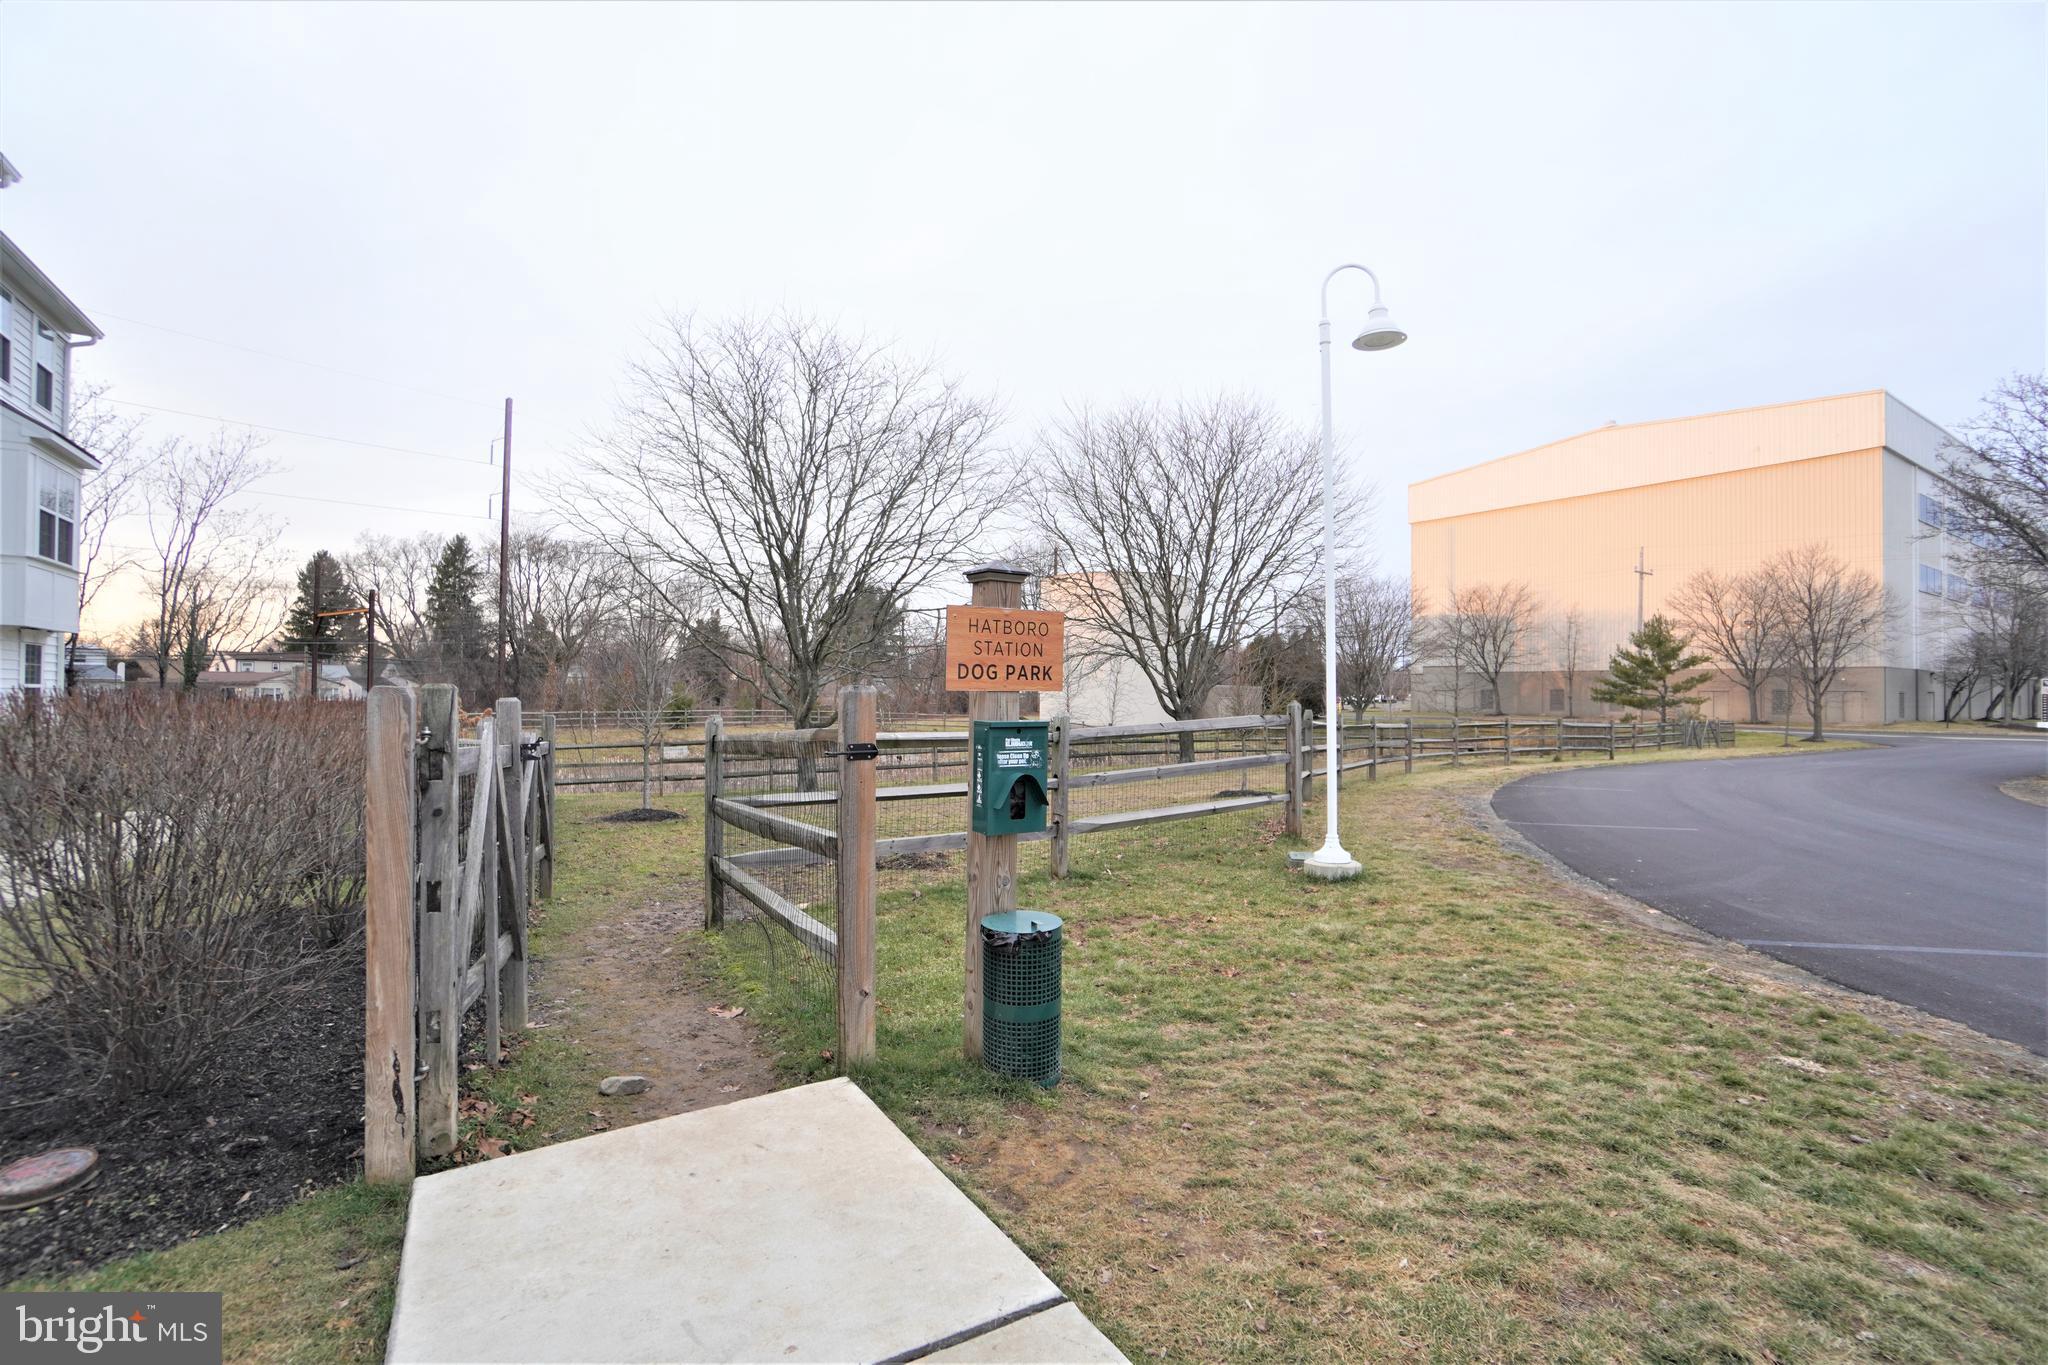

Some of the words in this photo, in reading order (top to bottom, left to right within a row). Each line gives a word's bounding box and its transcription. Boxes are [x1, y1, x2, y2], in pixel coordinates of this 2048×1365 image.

[968, 618, 1049, 637] HATBORO
[973, 640, 1043, 657] STATION
[957, 663, 998, 680] DOG
[1005, 664, 1053, 681] PARK
